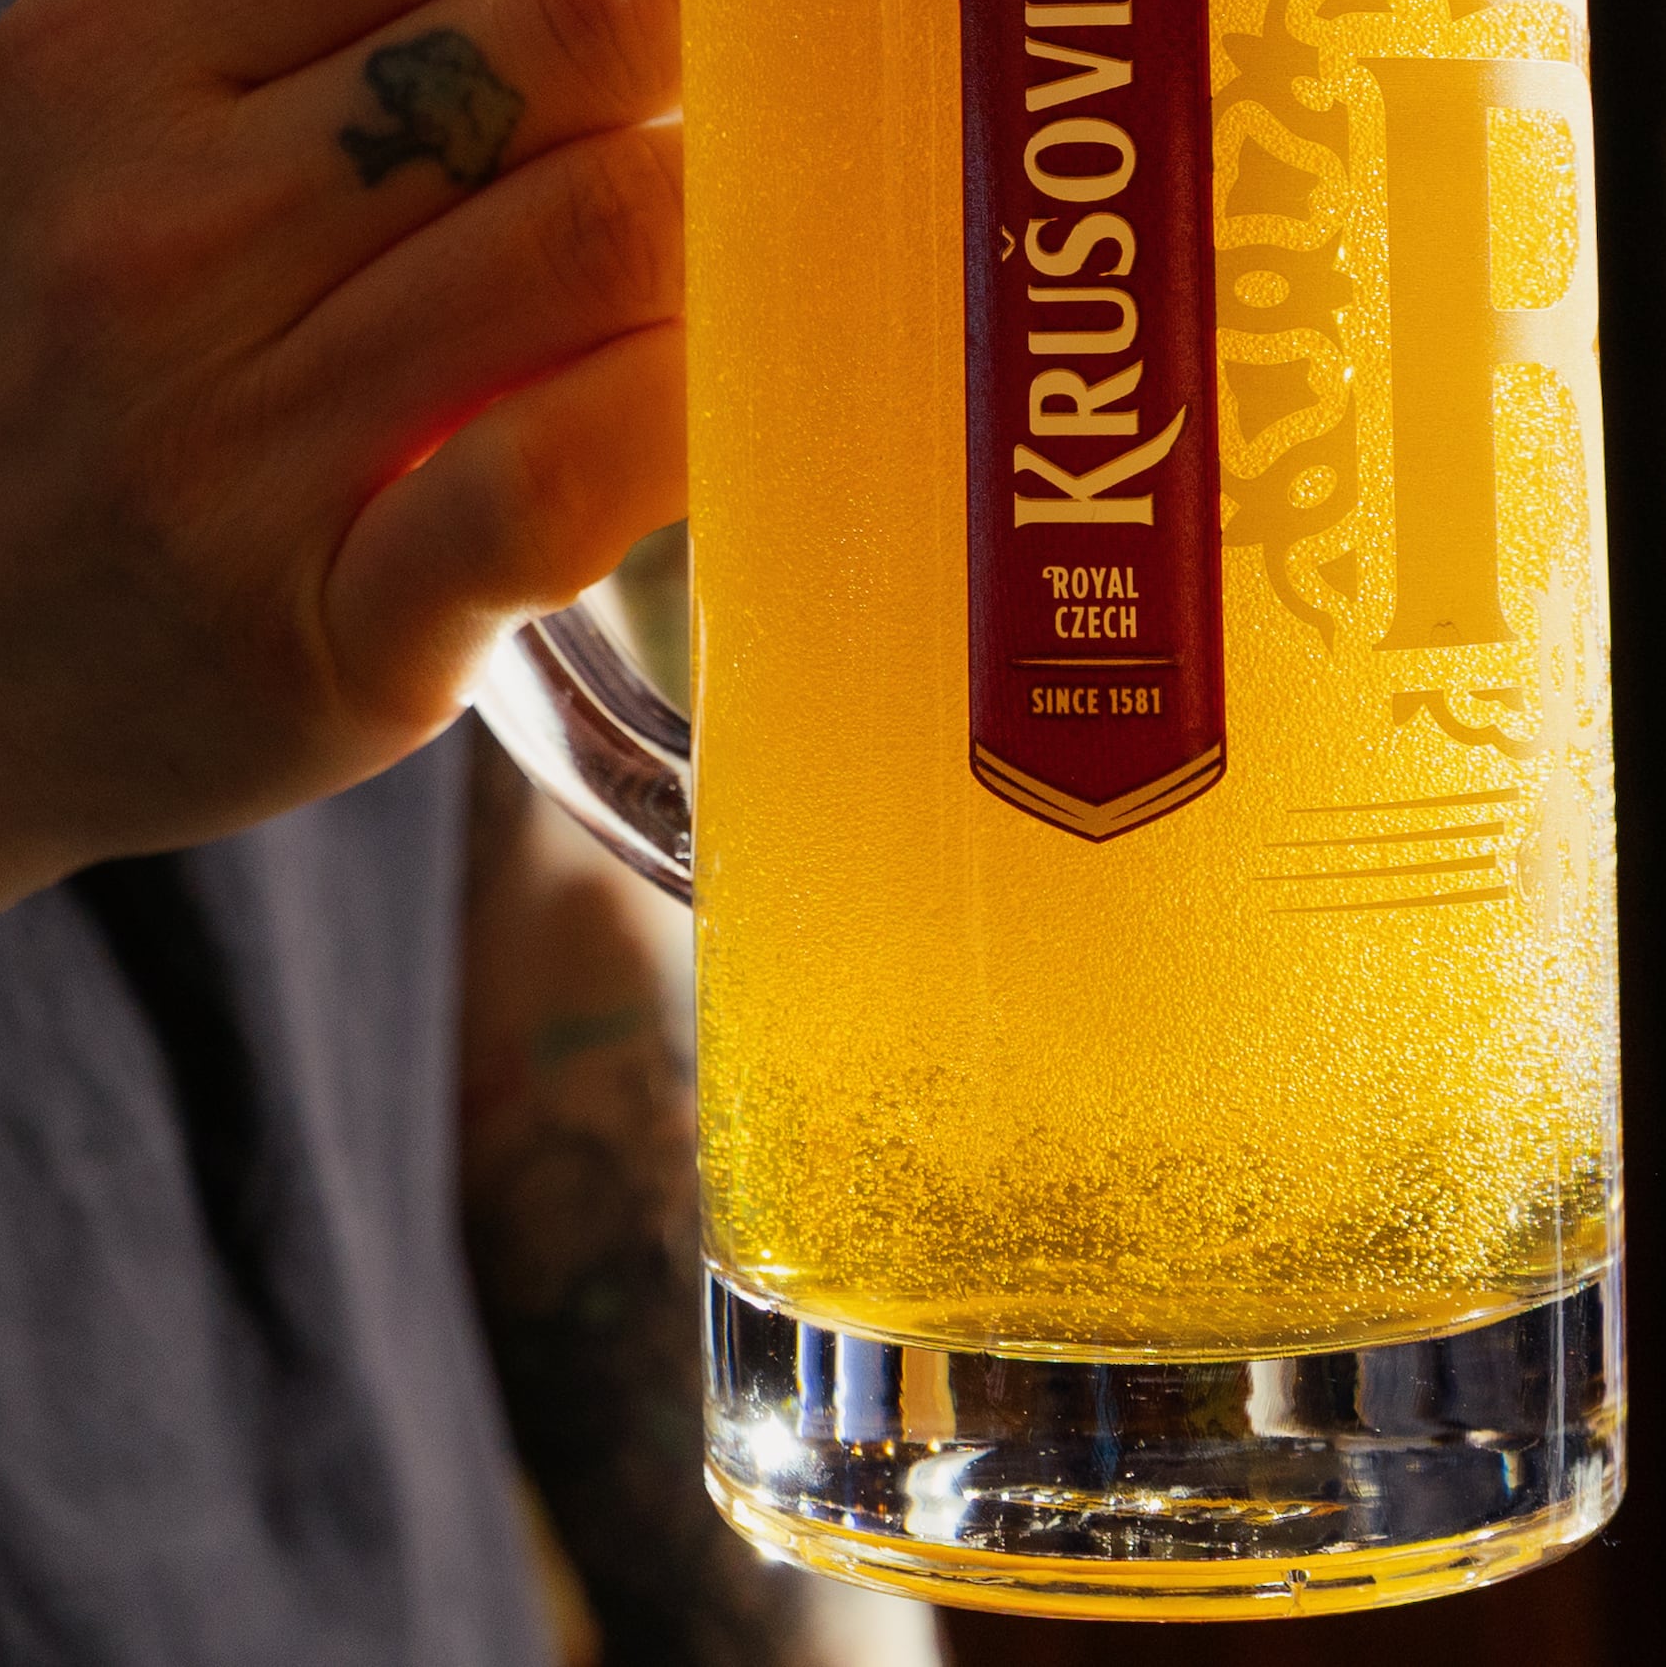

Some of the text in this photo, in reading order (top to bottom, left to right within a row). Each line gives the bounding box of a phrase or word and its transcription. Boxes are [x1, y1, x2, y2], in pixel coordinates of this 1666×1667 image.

[1042, 565, 1140, 600] ROYAL
[1054, 605, 1137, 639] CZECH
[1031, 687, 1161, 715] SINCE 1581
